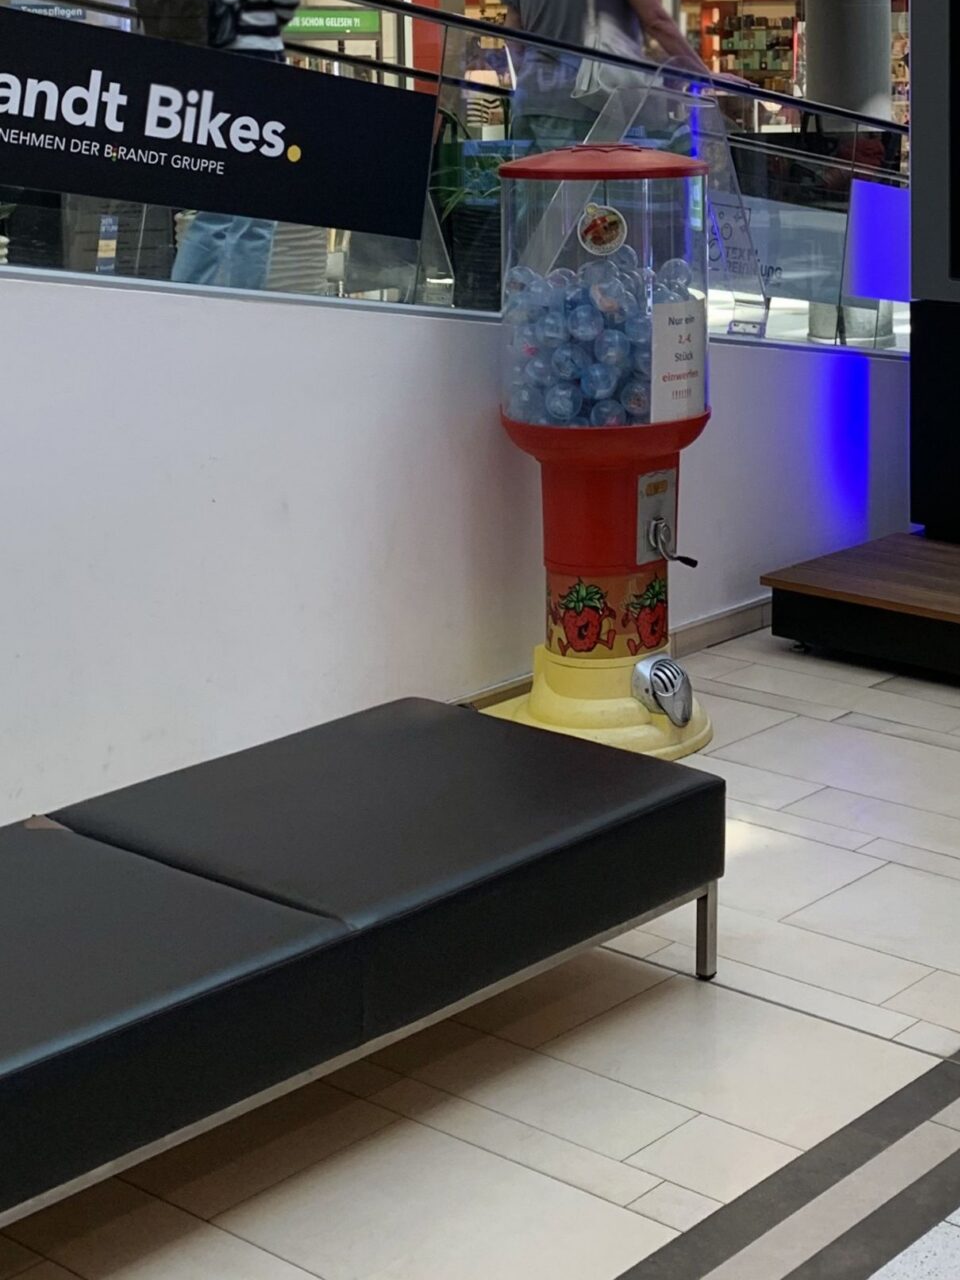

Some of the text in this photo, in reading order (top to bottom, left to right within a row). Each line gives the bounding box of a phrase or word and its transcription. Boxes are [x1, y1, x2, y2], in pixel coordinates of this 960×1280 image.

[144, 83, 302, 163] Bikes.
[70, 139, 99, 156] DER
[171, 157, 225, 175] GRUPPE
[668, 315, 695, 326] Nur ein
[674, 351, 693, 362] Stück
[662, 369, 699, 383] einwerfen
